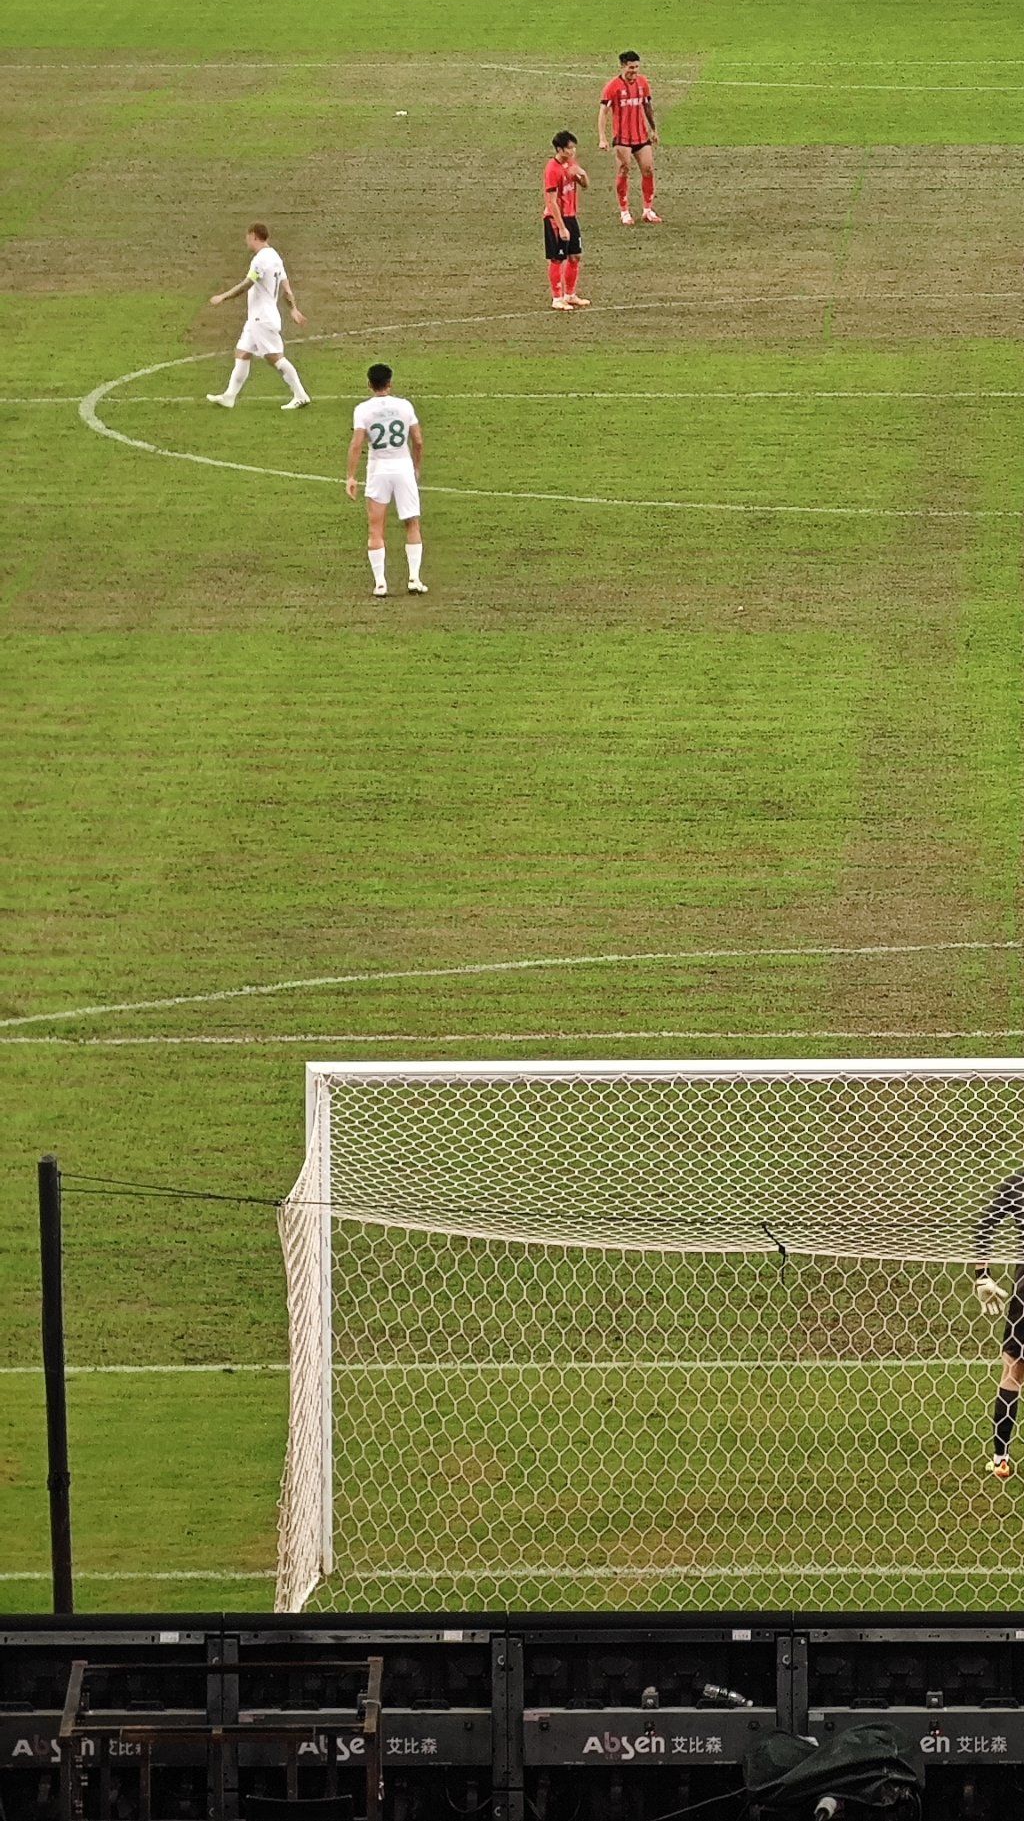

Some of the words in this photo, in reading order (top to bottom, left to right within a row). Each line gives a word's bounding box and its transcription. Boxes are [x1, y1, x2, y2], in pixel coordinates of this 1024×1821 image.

[370, 420, 405, 450] 28
[386, 1737, 438, 1755] 艾比森
[671, 1735, 723, 1754] 艾比森
[957, 1735, 1008, 1753] 艾比森
